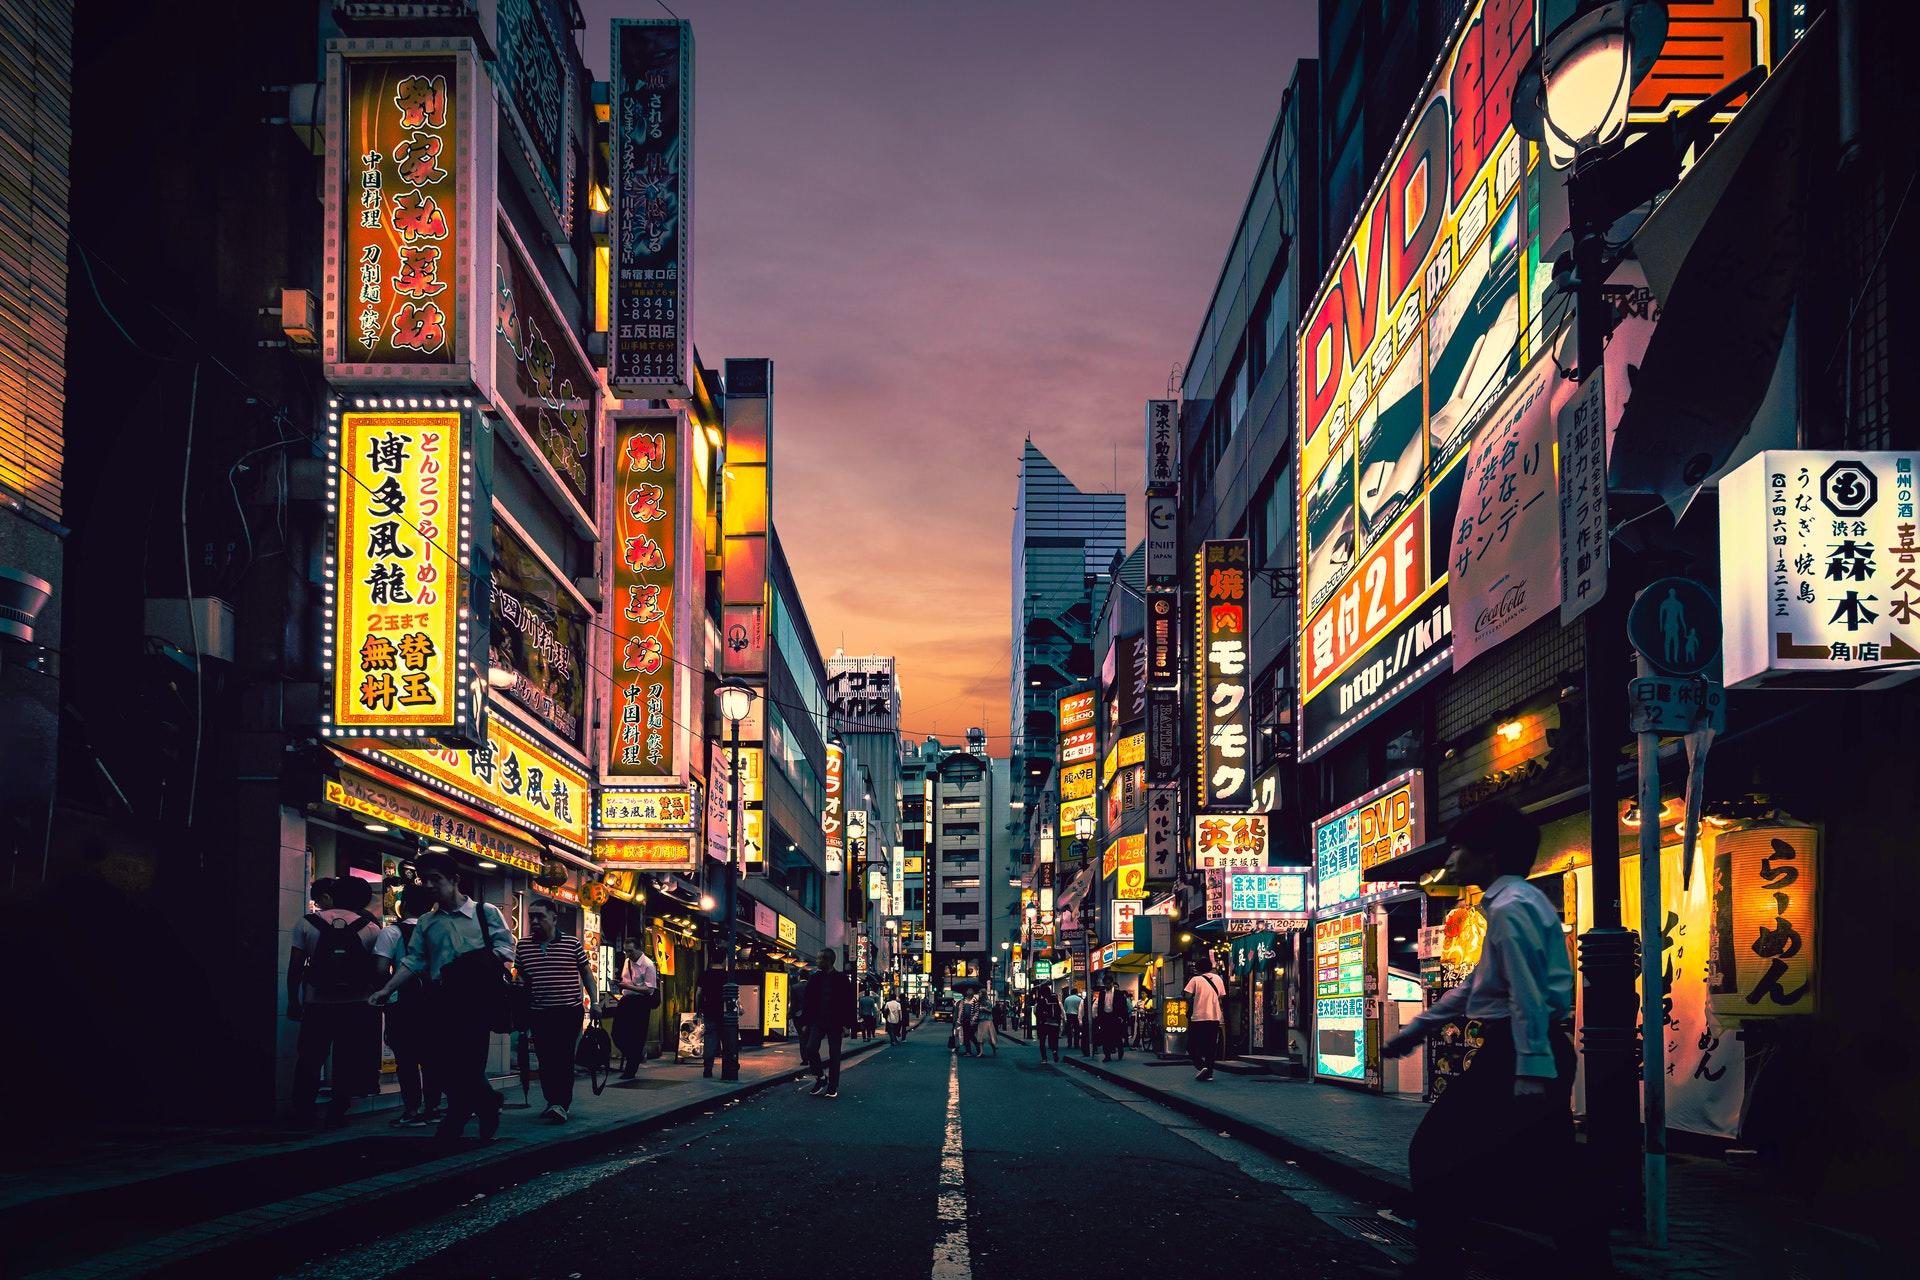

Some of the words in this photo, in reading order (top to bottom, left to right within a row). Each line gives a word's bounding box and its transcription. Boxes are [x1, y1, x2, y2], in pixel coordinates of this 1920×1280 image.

[361, 151, 382, 229] 中国料理
[621, 269, 677, 280] 新宿東口店
[632, 297, 674, 308] 3341
[620, 325, 676, 339] 五反田店
[632, 353, 674, 364] 3444
[1478, 431, 1519, 496] 渋谷
[1573, 400, 1592, 600] 防犯カメラ作動中
[1896, 458, 1913, 518] 信州の酒
[365, 432, 414, 606] 博多風龍
[417, 433, 440, 606] とんこつらーめん
[1794, 467, 1815, 603] うなぎ・焼鳥
[1832, 520, 1867, 537] 渋谷
[1208, 547, 1246, 562] 炭火
[1825, 540, 1880, 631] 森本
[367, 612, 428, 632] 2玉まで
[1340, 604, 1452, 715] http://ki
[1829, 641, 1880, 661] 角店
[1063, 697, 1094, 712] カラオケ
[1063, 715, 1076, 726] BIG
[1076, 710, 1095, 723] ECHO
[621, 684, 641, 765] 中国料理
[1063, 732, 1093, 747] カラオケ
[467, 741, 574, 824] 博多風龍
[826, 756, 841, 834] カラオケ
[605, 806, 657, 818] 博多風龍
[1361, 790, 1411, 846] DVD
[1198, 818, 1266, 854] 英鮨
[1318, 821, 1348, 852] 金太郎
[1218, 857, 1259, 867] 道玄坂店
[1318, 841, 1359, 878] 渋谷書店
[1233, 876, 1268, 892] 金太郎
[1233, 893, 1280, 909] 渋谷書店
[1745, 838, 1808, 1005] らーめん
[1677, 923, 1686, 981] ヒカリ
[1667, 1018, 1680, 1077] ヒシオ
